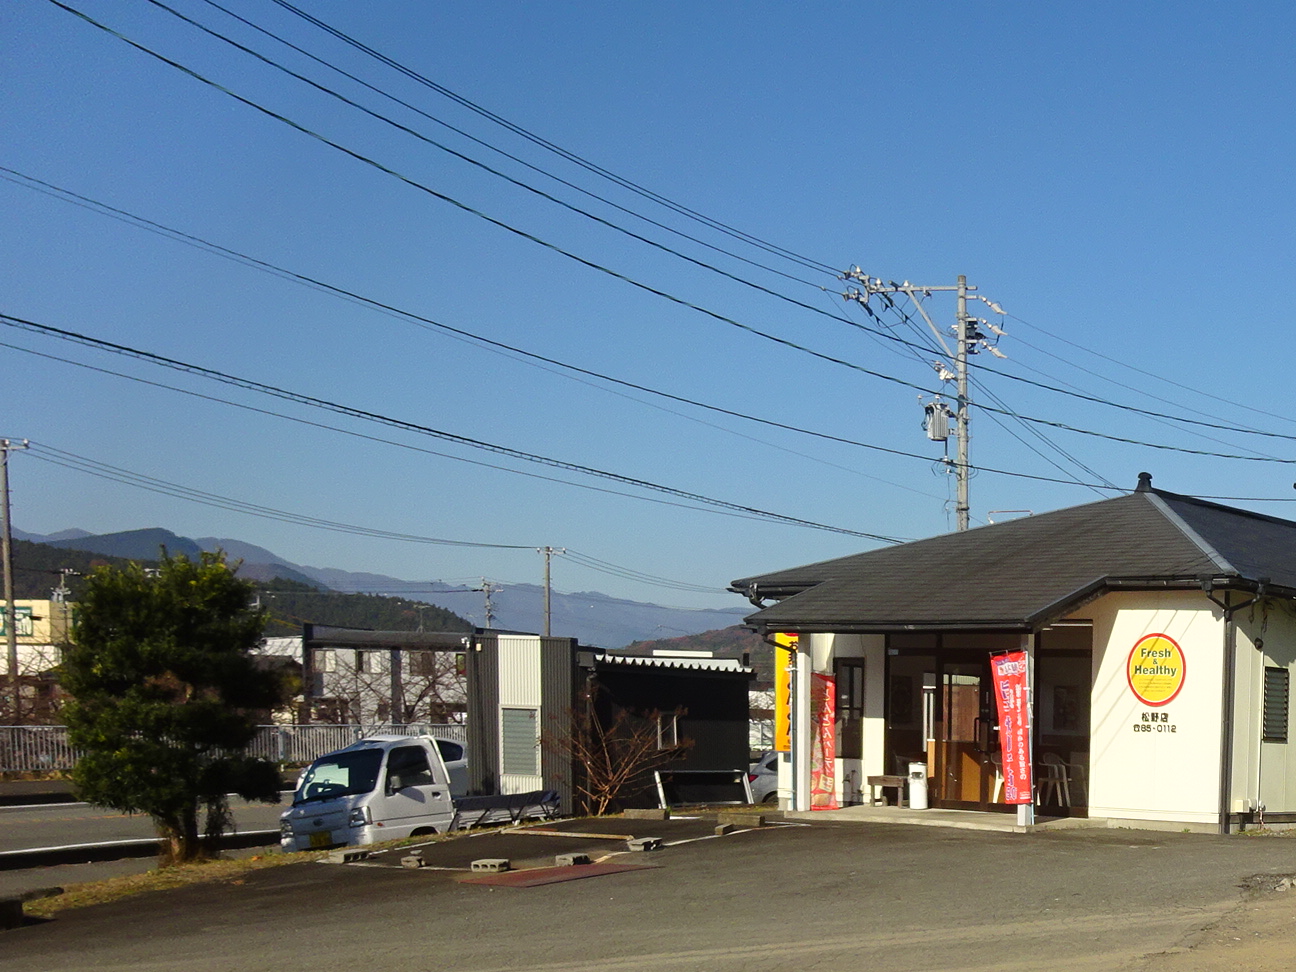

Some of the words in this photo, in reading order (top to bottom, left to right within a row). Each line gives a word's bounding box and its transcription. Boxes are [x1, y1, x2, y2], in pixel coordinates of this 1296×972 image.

[1141, 648, 1171, 657] Fresh
[1134, 665, 1177, 677] Healthy
[1141, 712, 1169, 723] 松野店
